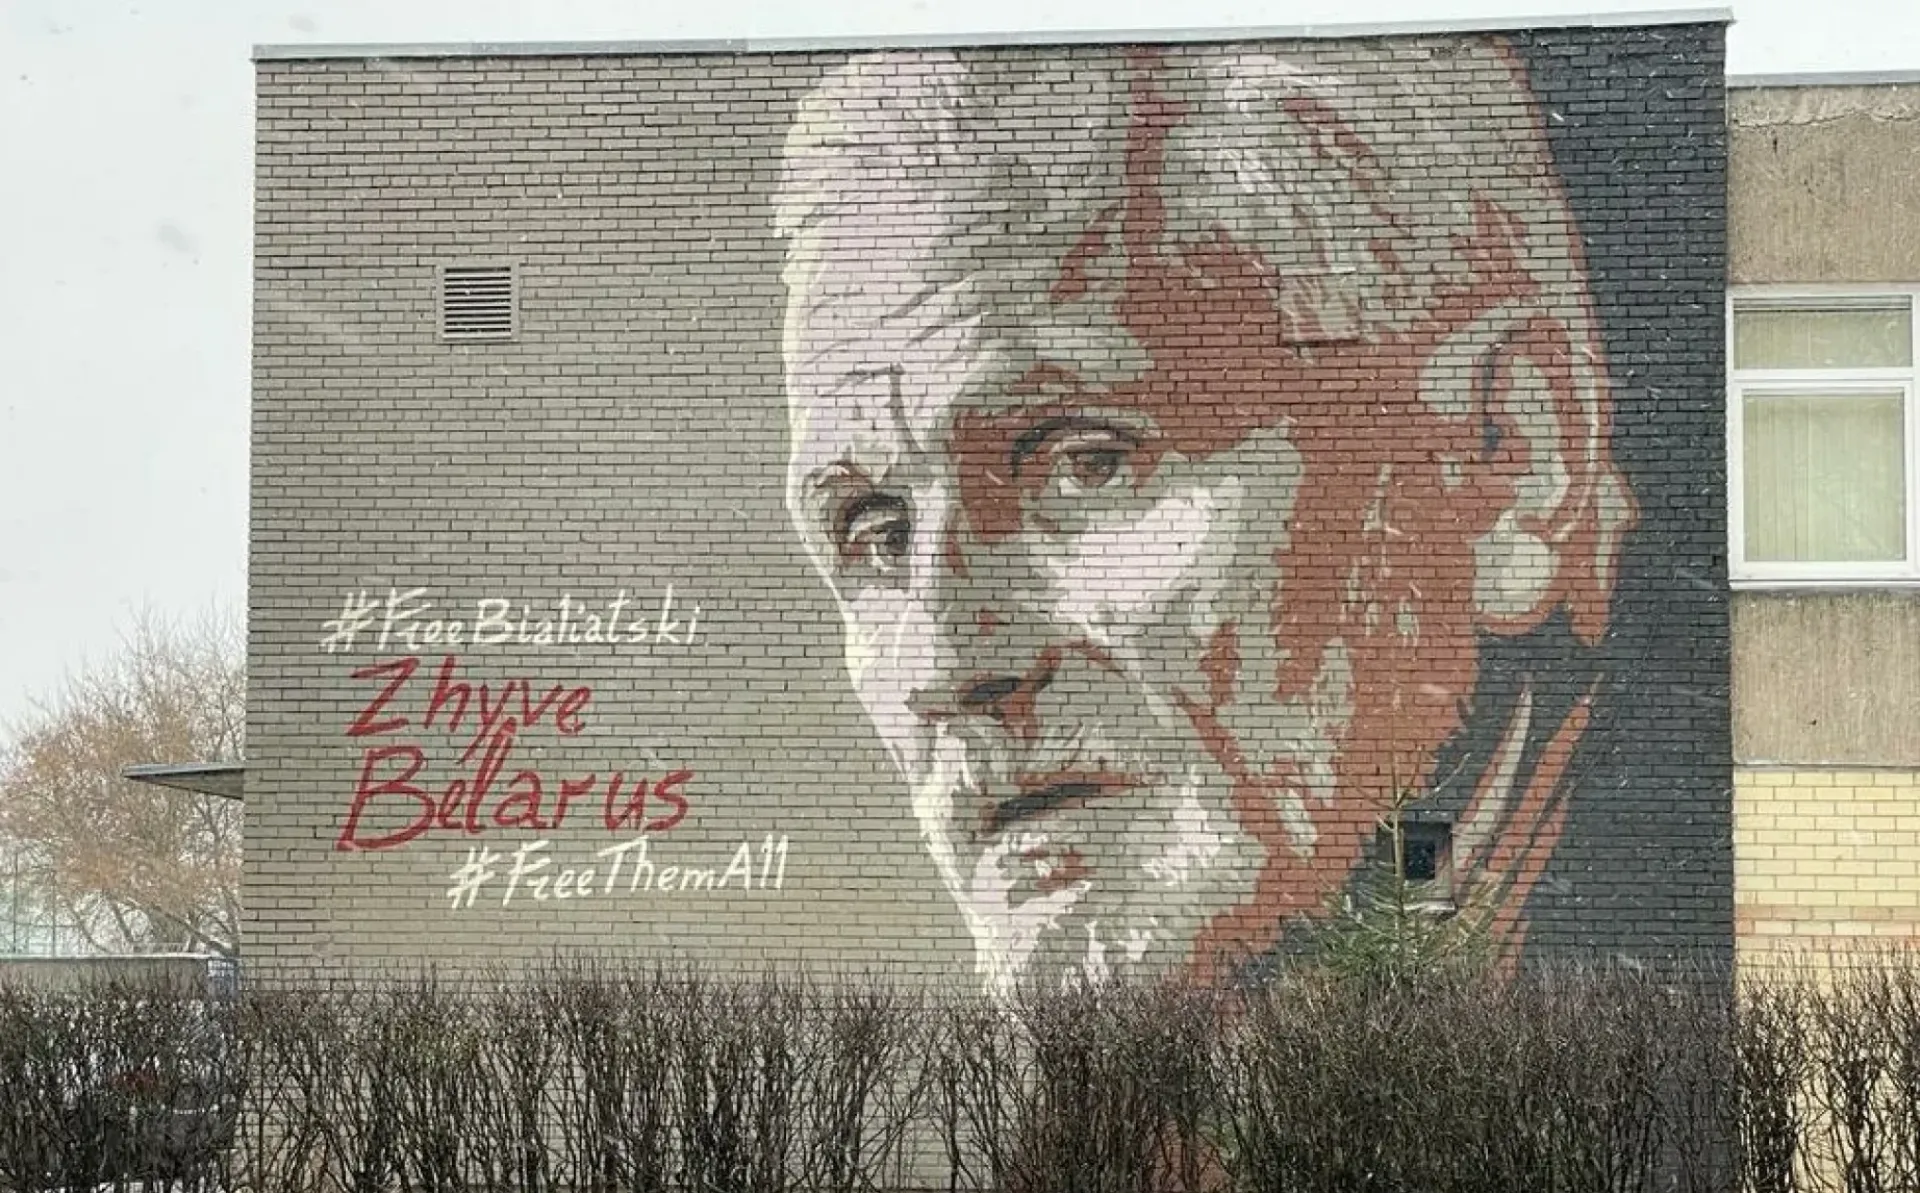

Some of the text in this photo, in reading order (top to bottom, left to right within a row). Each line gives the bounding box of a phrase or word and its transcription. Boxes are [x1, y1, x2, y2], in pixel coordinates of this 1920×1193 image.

[346, 653, 593, 764] Zhyve
[336, 717, 695, 851] Belarus
[446, 834, 788, 909] #FreeThemAll
